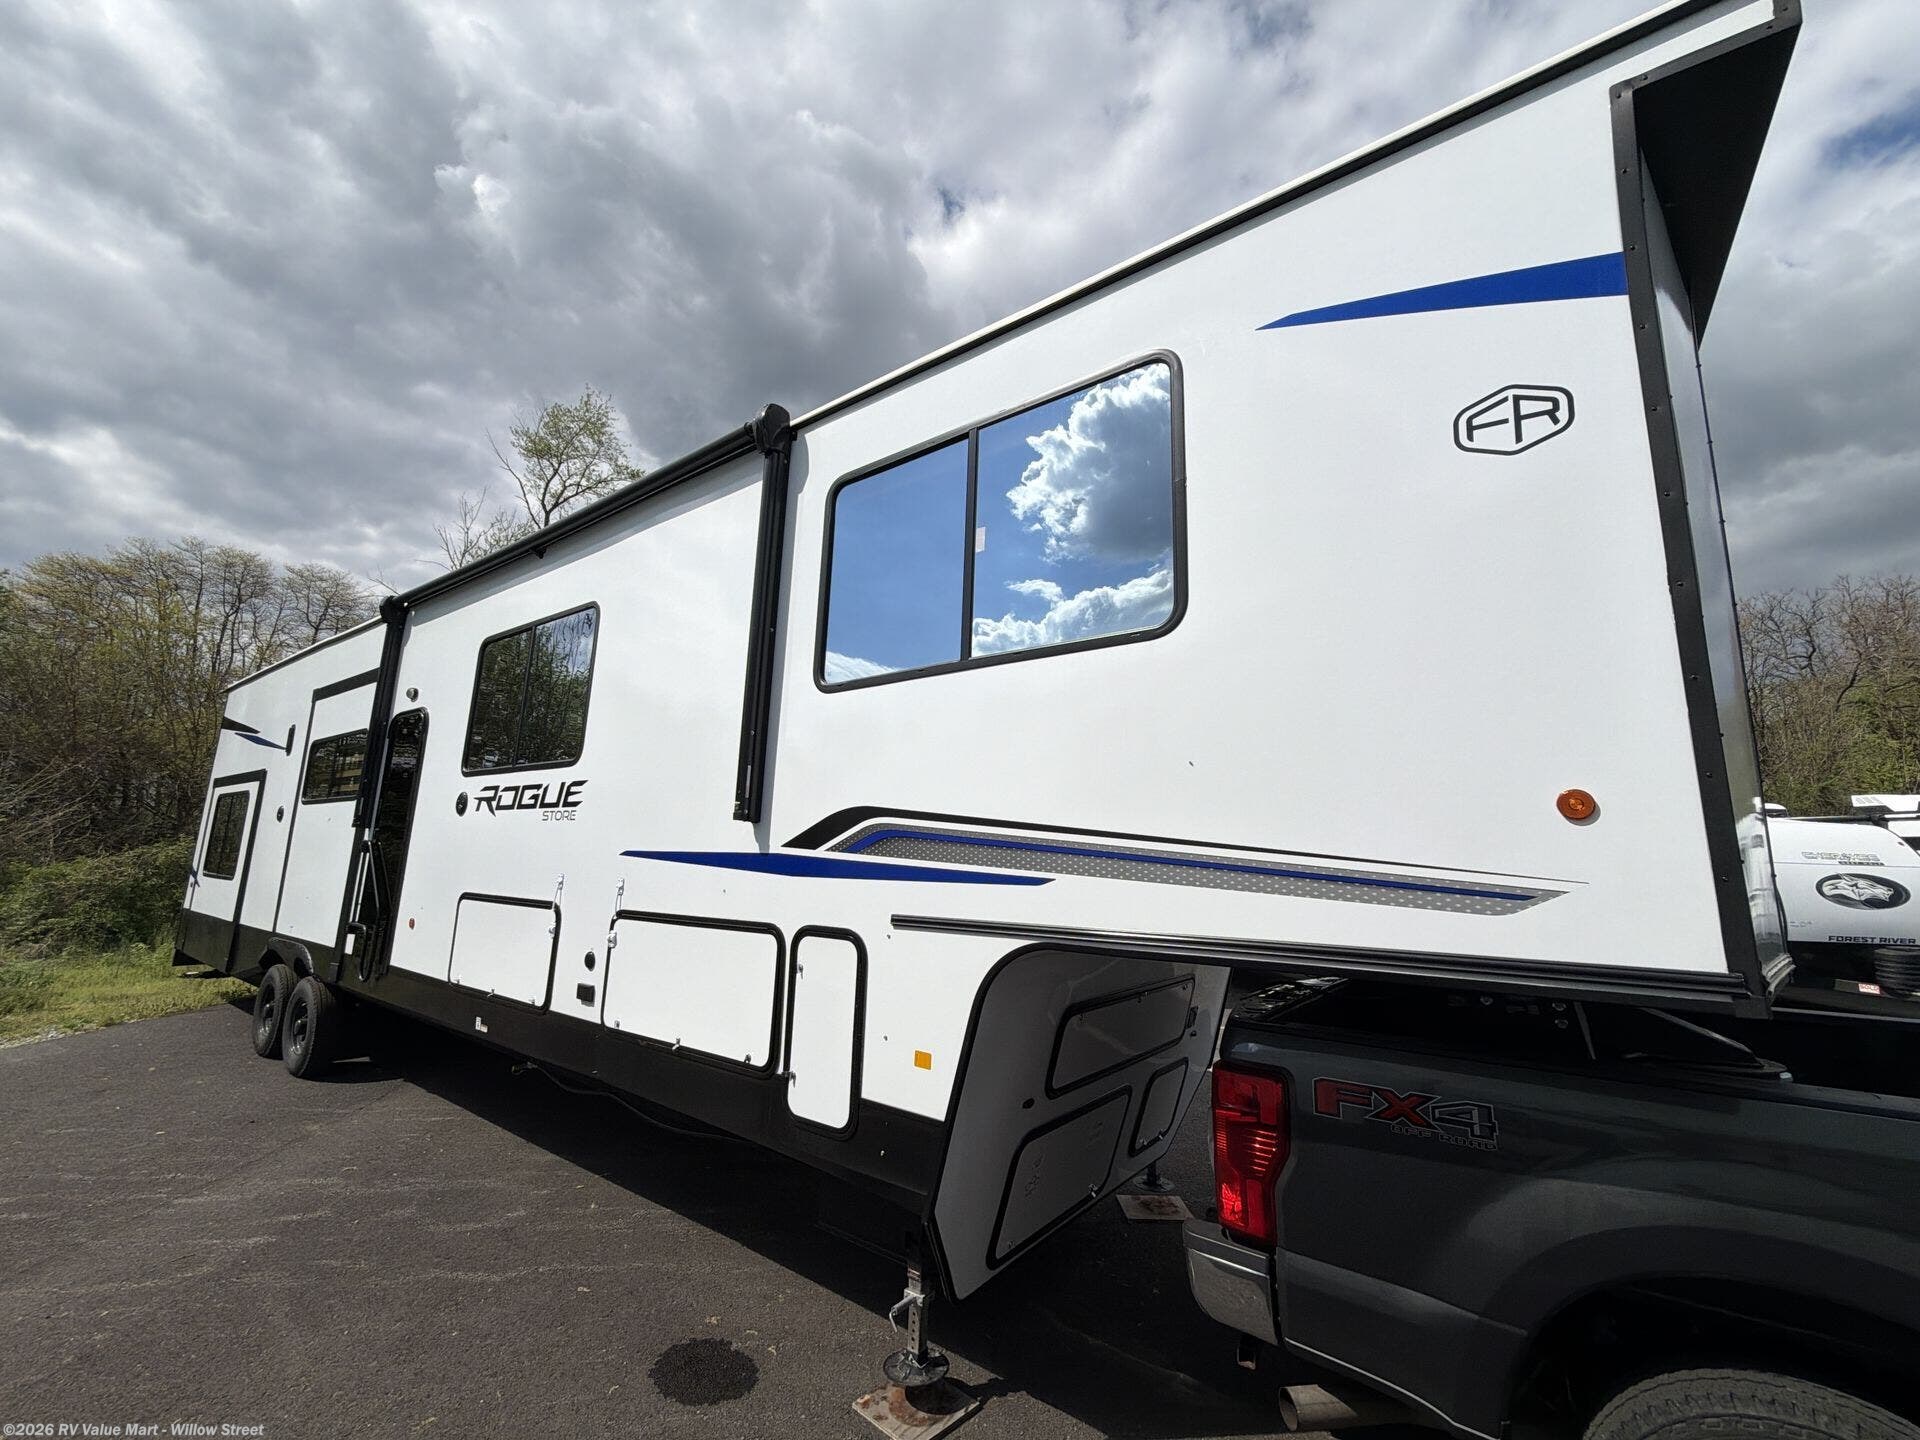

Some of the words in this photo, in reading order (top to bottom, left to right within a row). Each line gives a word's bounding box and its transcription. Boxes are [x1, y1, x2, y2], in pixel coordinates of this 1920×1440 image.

[1465, 394, 1561, 445] FR
[473, 780, 589, 817] ROGUE
[541, 810, 577, 821] STORE
[1828, 935, 1877, 944] FOREST
[1878, 936, 1917, 945] RIVER
[1312, 1077, 1499, 1144] FX4
[1390, 1123, 1433, 1138] OFF
[1439, 1133, 1498, 1151] ROAD
